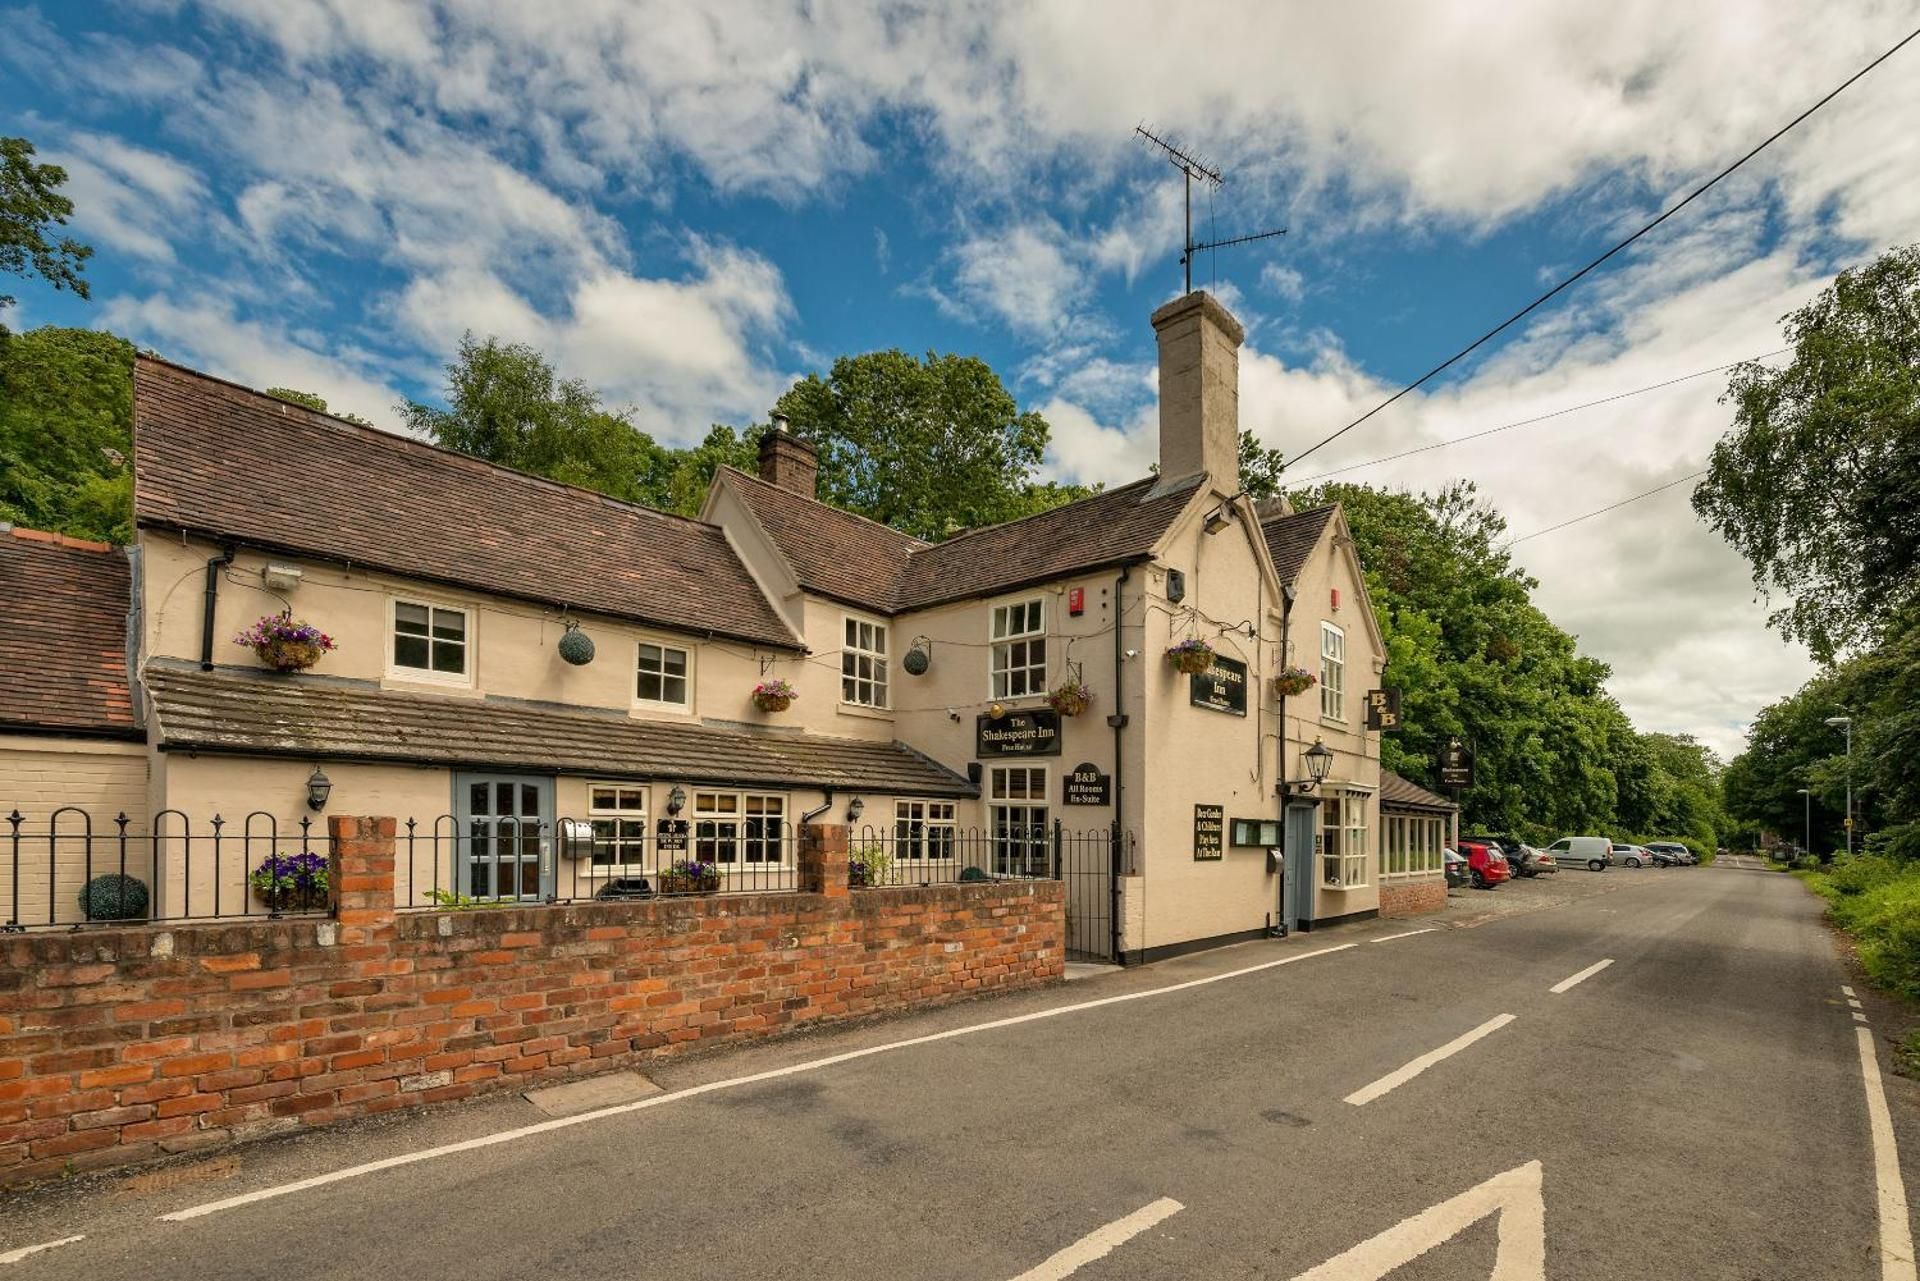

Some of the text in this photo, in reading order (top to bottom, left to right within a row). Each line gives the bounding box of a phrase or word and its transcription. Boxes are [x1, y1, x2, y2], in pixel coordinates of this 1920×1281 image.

[1214, 681, 1226, 695] Inn
[1371, 693, 1386, 706] B
[1376, 706, 1387, 714] &
[1010, 718, 1026, 727] The
[1381, 713, 1395, 726] B
[982, 726, 1055, 742] Shakespeare Inn
[1074, 772, 1097, 783] B&B
[1068, 785, 1103, 793] All Rooms
[1070, 794, 1100, 803] En-Suite
